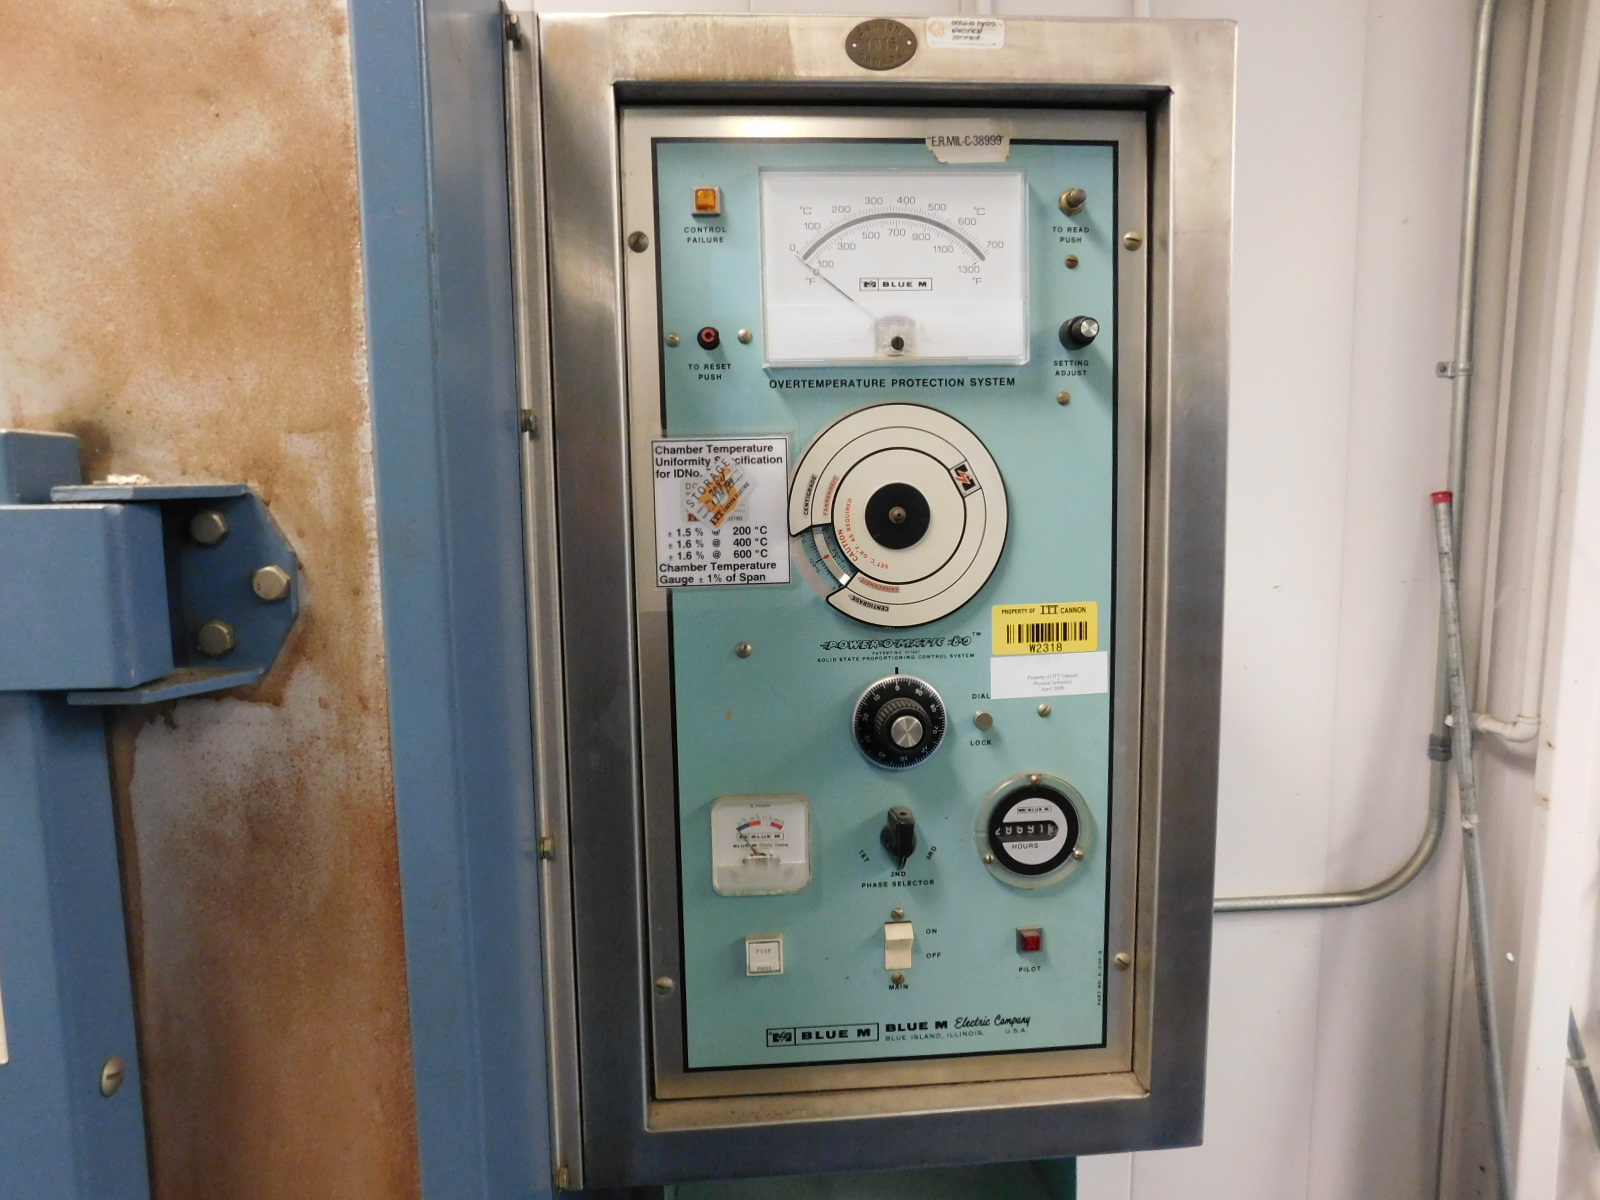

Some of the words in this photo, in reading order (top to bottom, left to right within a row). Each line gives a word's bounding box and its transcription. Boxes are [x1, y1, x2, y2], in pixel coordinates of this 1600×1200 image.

[865, 197, 883, 205] 300
[897, 196, 916, 204] 400
[831, 205, 851, 214] 200
[928, 203, 947, 212] 500
[804, 222, 821, 230] 100
[958, 217, 977, 226] 600
[862, 232, 880, 240] 500
[888, 229, 906, 237] 700
[912, 233, 931, 241] 900
[789, 243, 796, 252] 0
[837, 242, 856, 250] 300
[933, 245, 954, 253] 1100
[986, 240, 1004, 249] 700
[818, 260, 835, 268] 100
[958, 265, 980, 273] 1300
[769, 378, 886, 389] OVERTEMPERATURE
[891, 378, 964, 388] PROTECTION
[970, 377, 1015, 386] SYSTEM
[655, 445, 703, 455] Chamber
[706, 444, 773, 456] Temperature
[655, 457, 711, 468] Uniformity
[714, 455, 783, 466] Scification
[656, 470, 671, 478] for
[673, 469, 703, 478] IDNo.
[686, 458, 731, 508] STORAGE
[803, 475, 817, 516] CENTIGRADE
[823, 475, 838, 516] FAHRENHEIT
[845, 498, 853, 532] REQUIRED
[676, 529, 692, 537] 1.5
[695, 528, 704, 537] %
[733, 527, 752, 535] 200
[677, 541, 692, 549] 1.6
[695, 540, 704, 549] %
[733, 539, 752, 547] 400
[837, 529, 858, 562] CAUTION
[677, 552, 692, 560] 1.6
[695, 551, 704, 560] %
[733, 550, 752, 558] 600
[659, 563, 707, 572] Chamber
[710, 562, 777, 573] Temperature
[659, 575, 694, 586] Gauge
[726, 573, 736, 582] of
[739, 573, 766, 584] Span
[859, 577, 900, 593] FAHRENHEIT
[851, 595, 890, 612] CENTIGRADE
[1040, 604, 1059, 615] ITT
[1060, 606, 1087, 614] CANNON
[1029, 642, 1063, 653] W2318
[932, 725, 939, 735] 70
[1012, 842, 1039, 850] HOURS
[859, 849, 870, 863] 1ST
[926, 845, 937, 861] 3RD
[861, 881, 889, 889] PHASE
[892, 880, 935, 888] SELECTOR
[1018, 965, 1042, 973] PILOT
[885, 1022, 929, 1033] BLUE
[934, 1020, 948, 1030] M
[954, 1016, 991, 1029] Electric
[994, 1013, 1032, 1029] Company
[801, 1028, 849, 1040] BLUE
[856, 1027, 872, 1038] M
